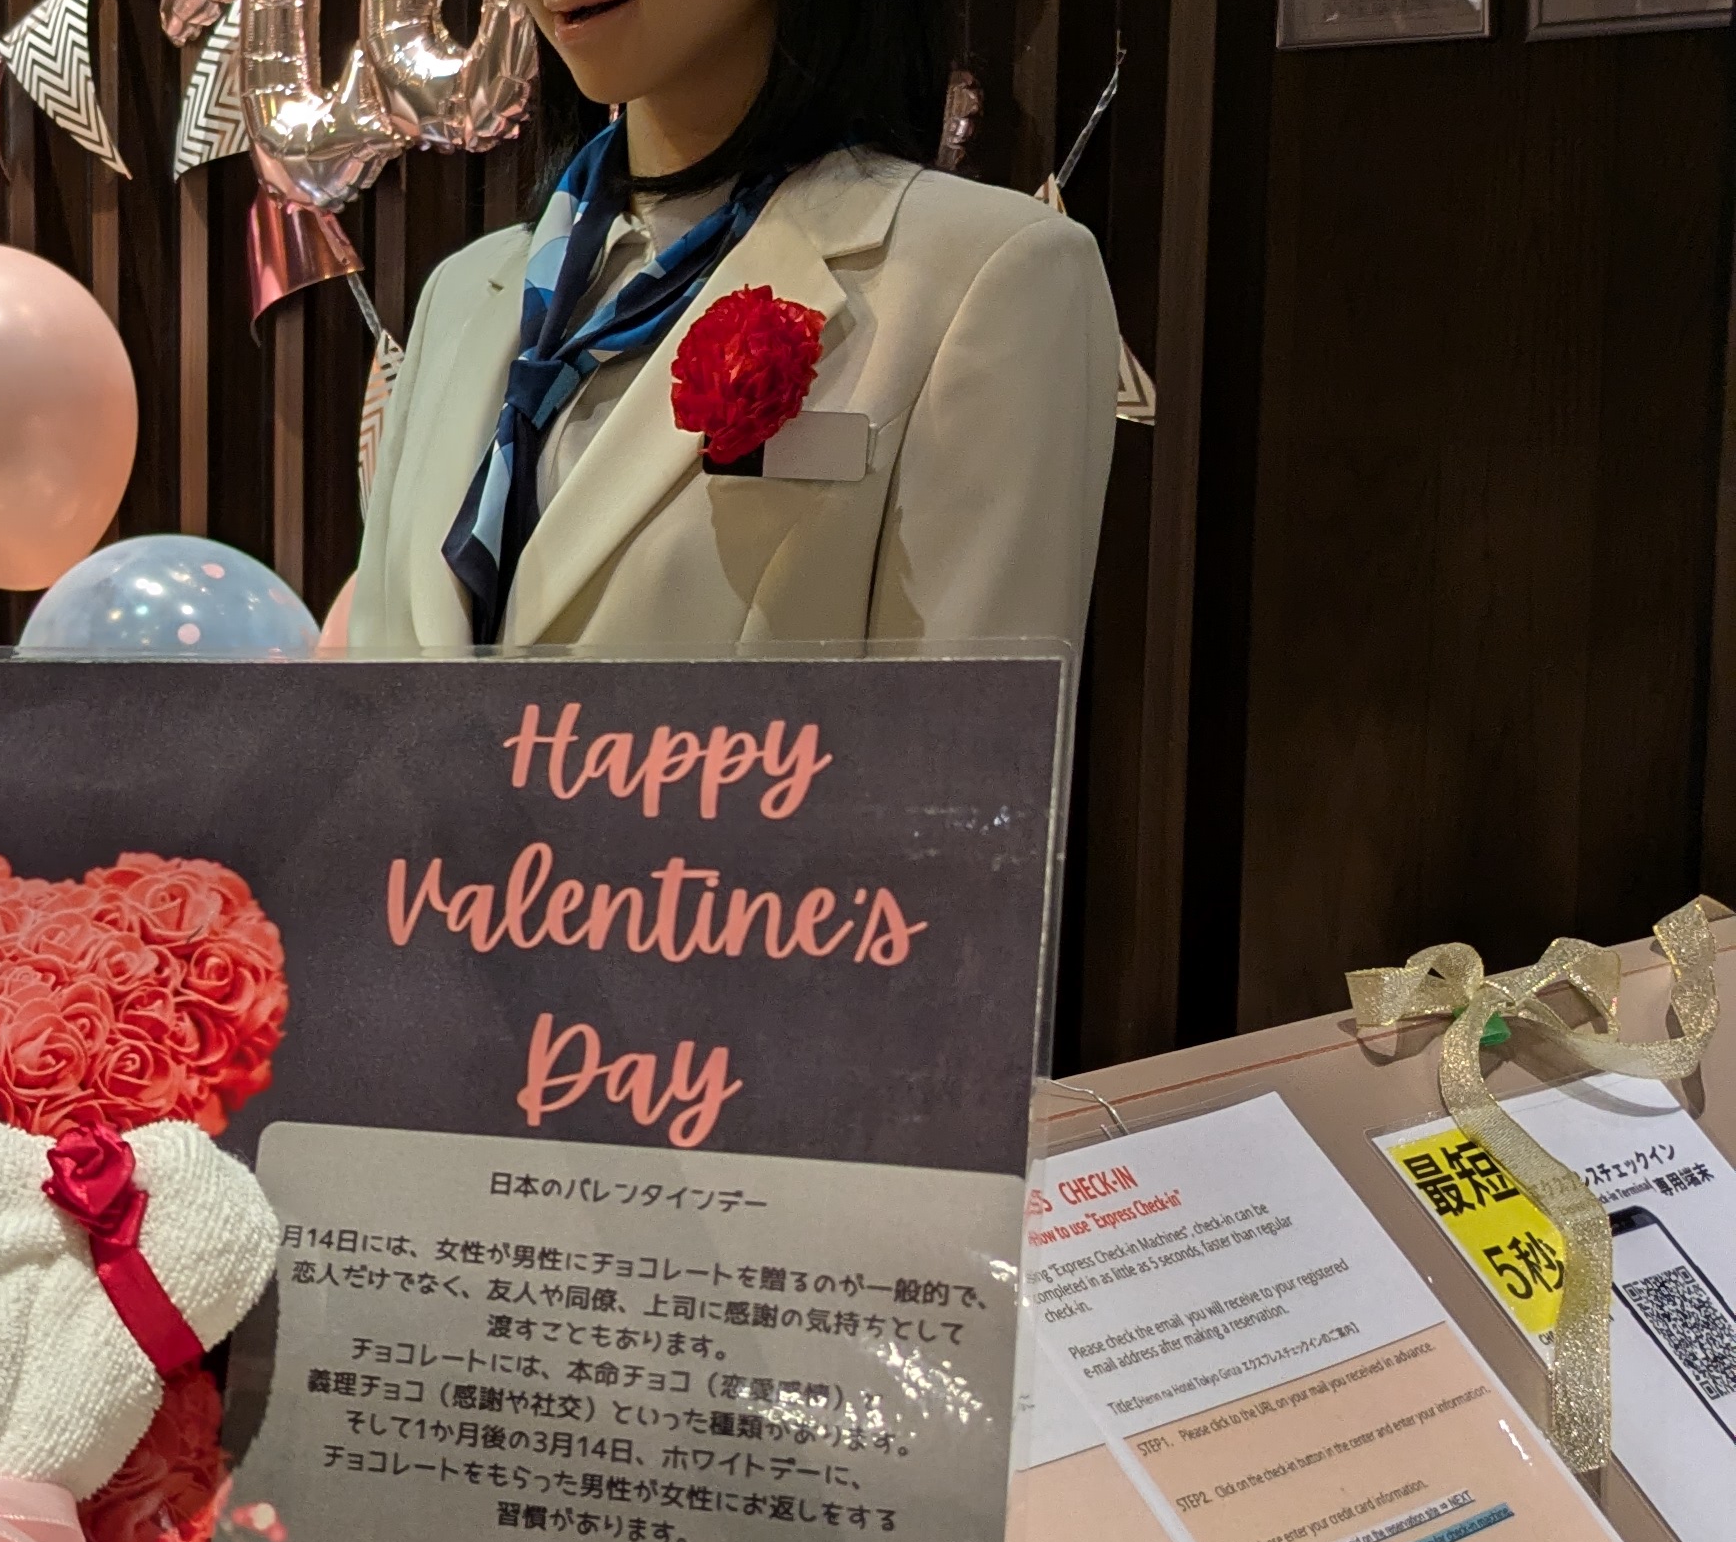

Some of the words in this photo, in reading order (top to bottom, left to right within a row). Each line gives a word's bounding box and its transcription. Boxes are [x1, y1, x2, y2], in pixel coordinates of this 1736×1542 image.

[502, 702, 834, 821] Happy
[386, 842, 929, 967] Valentine's
[516, 1011, 743, 1149] Day
[1058, 1165, 1139, 1206] CHECK-IN
[1402, 1140, 1521, 1218] 最短
[1053, 1226, 1071, 1240] to
[1068, 1220, 1092, 1236] use
[1482, 1230, 1566, 1301] 5秒
[486, 1313, 727, 1361] 渡すこともあります。
[1044, 1301, 1093, 1323] check-in.
[1067, 1341, 1107, 1360] Please
[1105, 1329, 1138, 1349] check
[1134, 1325, 1156, 1339] the
[1154, 1314, 1185, 1333] email
[1185, 1309, 1207, 1327] you
[1204, 1300, 1226, 1316] will
[1223, 1291, 1262, 1310] receive
[1259, 1287, 1274, 1299] to
[1271, 1278, 1296, 1299] your
[1296, 1257, 1349, 1287] registered
[1083, 1356, 1119, 1379] e-mail
[1117, 1346, 1160, 1368] address
[1157, 1338, 1183, 1354] after
[1183, 1323, 1225, 1346] making
[1221, 1323, 1231, 1334] a
[1228, 1295, 1290, 1332] reservation.
[323, 1444, 897, 1532] チョコレートをもらった男性が女性にお返しをする
